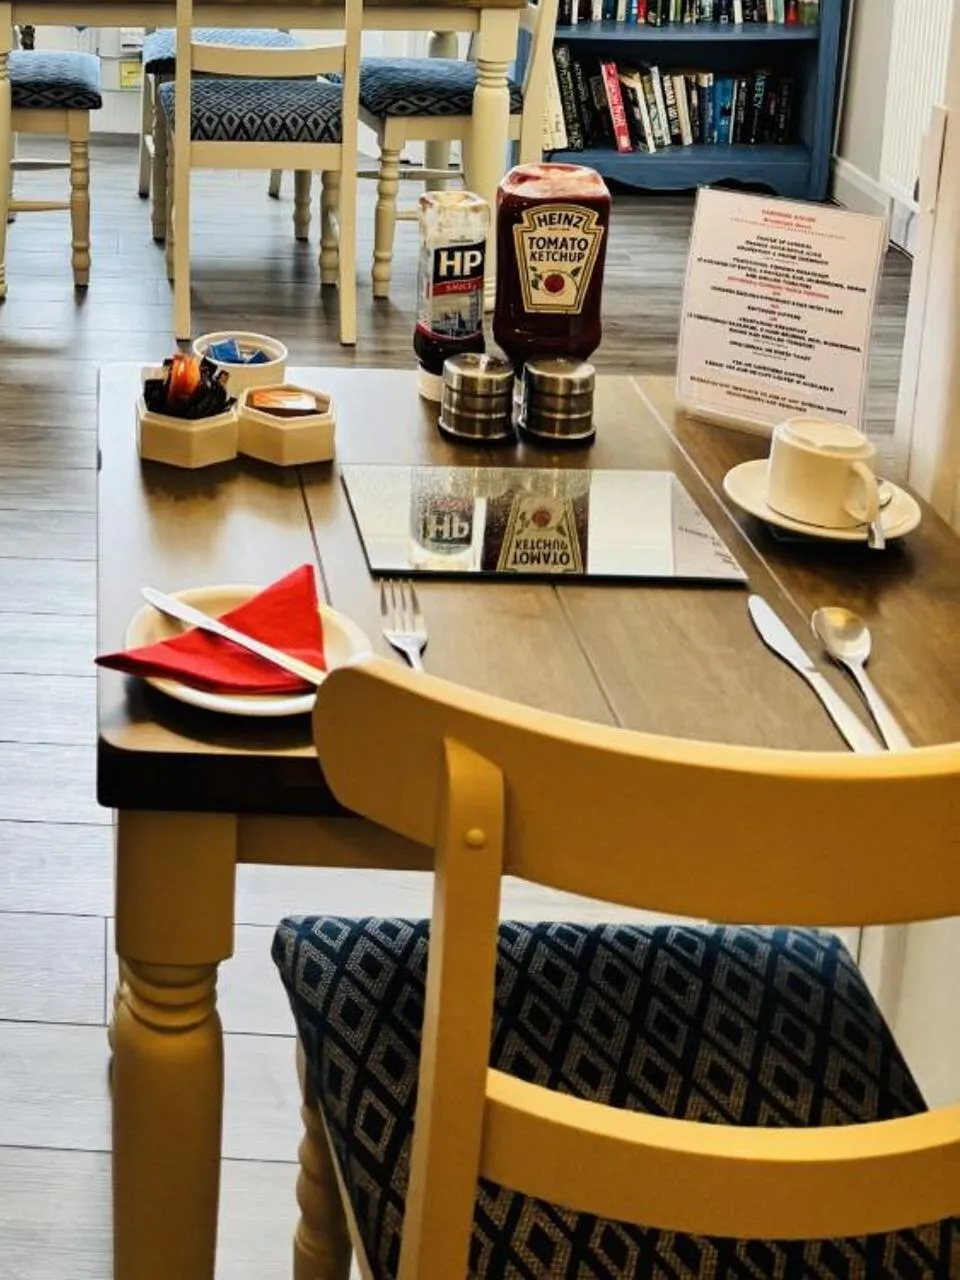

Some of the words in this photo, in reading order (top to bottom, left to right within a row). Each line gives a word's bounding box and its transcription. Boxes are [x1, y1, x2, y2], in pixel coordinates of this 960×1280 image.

[536, 212, 584, 229] HEINZ
[528, 236, 589, 251] TOMATO
[439, 250, 482, 276] HP
[530, 250, 585, 263] KETCHUP
